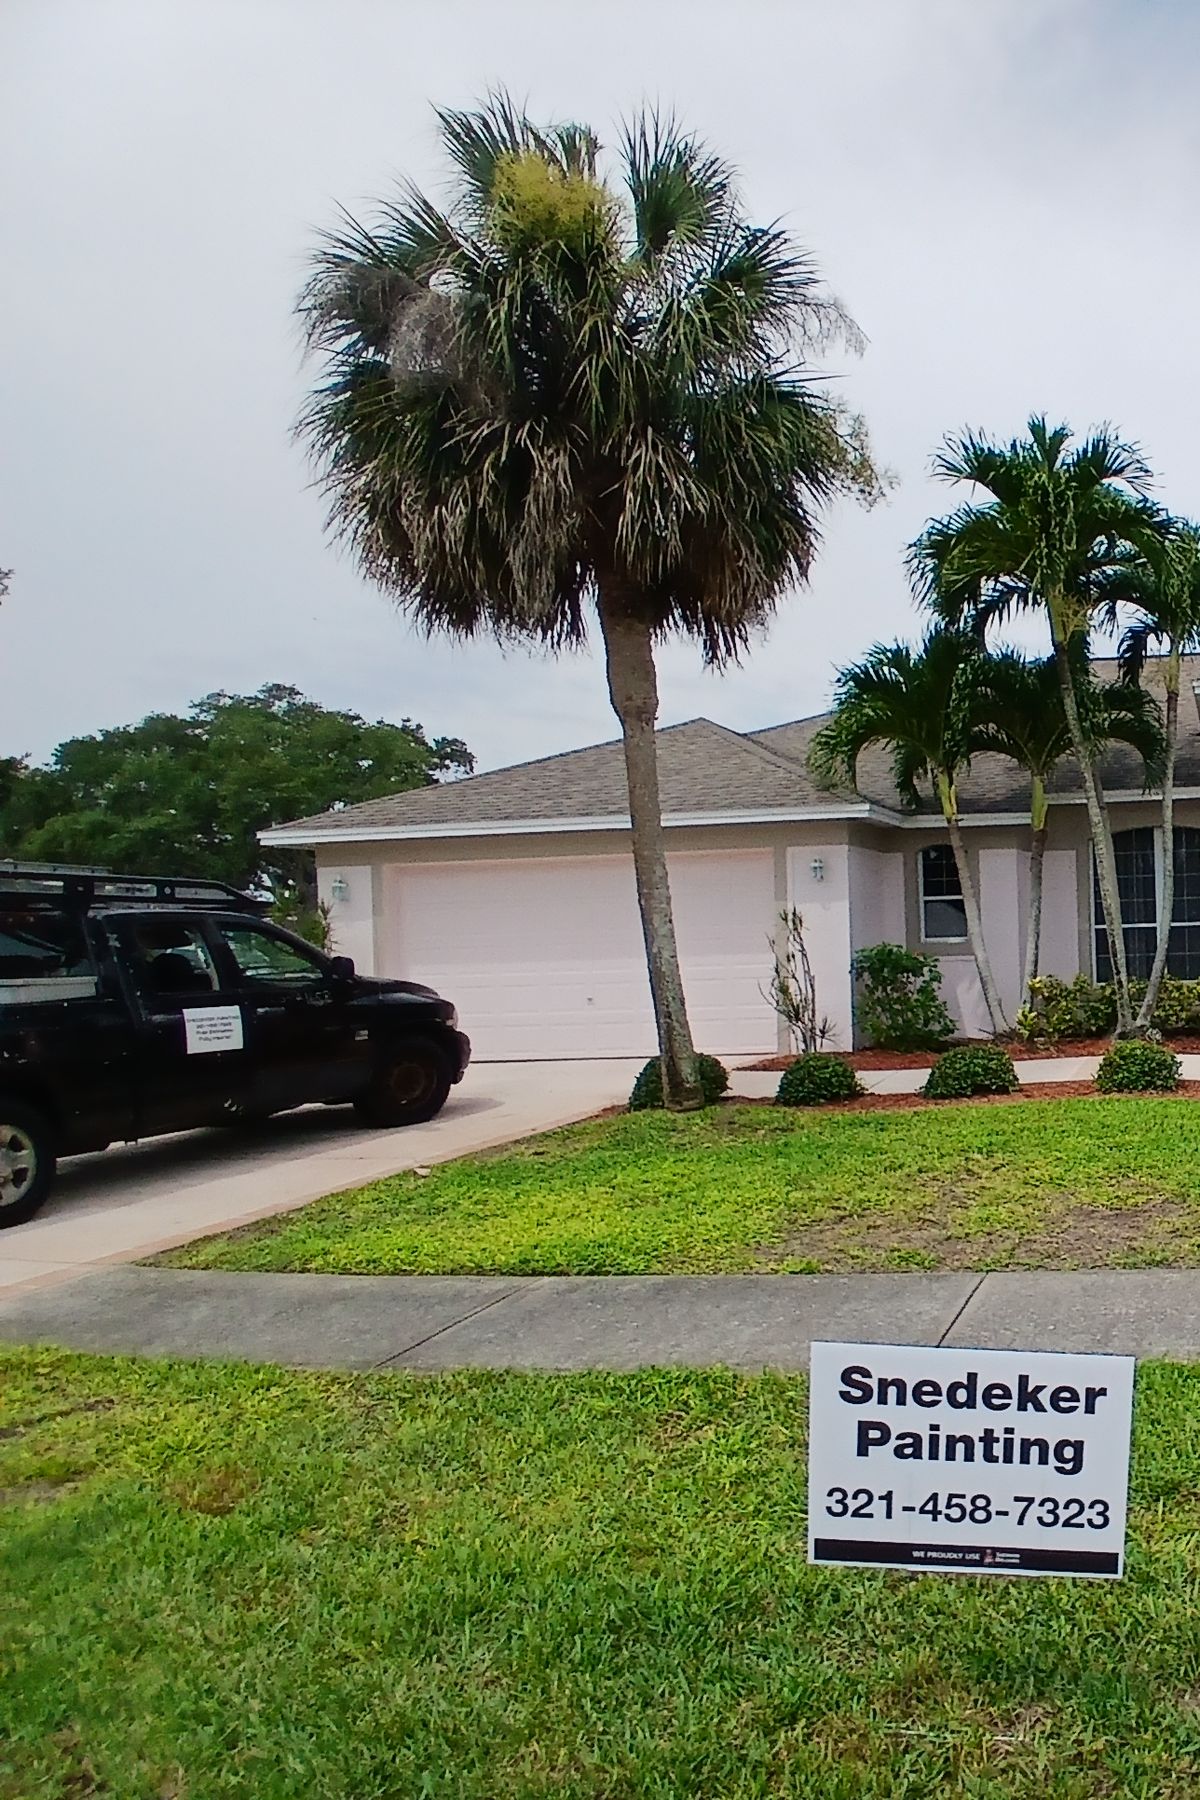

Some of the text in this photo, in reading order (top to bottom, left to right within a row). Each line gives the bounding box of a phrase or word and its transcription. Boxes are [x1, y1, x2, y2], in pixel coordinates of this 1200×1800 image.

[838, 1365, 1108, 1415] Snedeker
[856, 1419, 1085, 1476] Painting
[825, 1486, 1110, 1530] 321-458-7323
[927, 1551, 963, 1560] PROUDLY
[965, 1552, 980, 1560] USE
